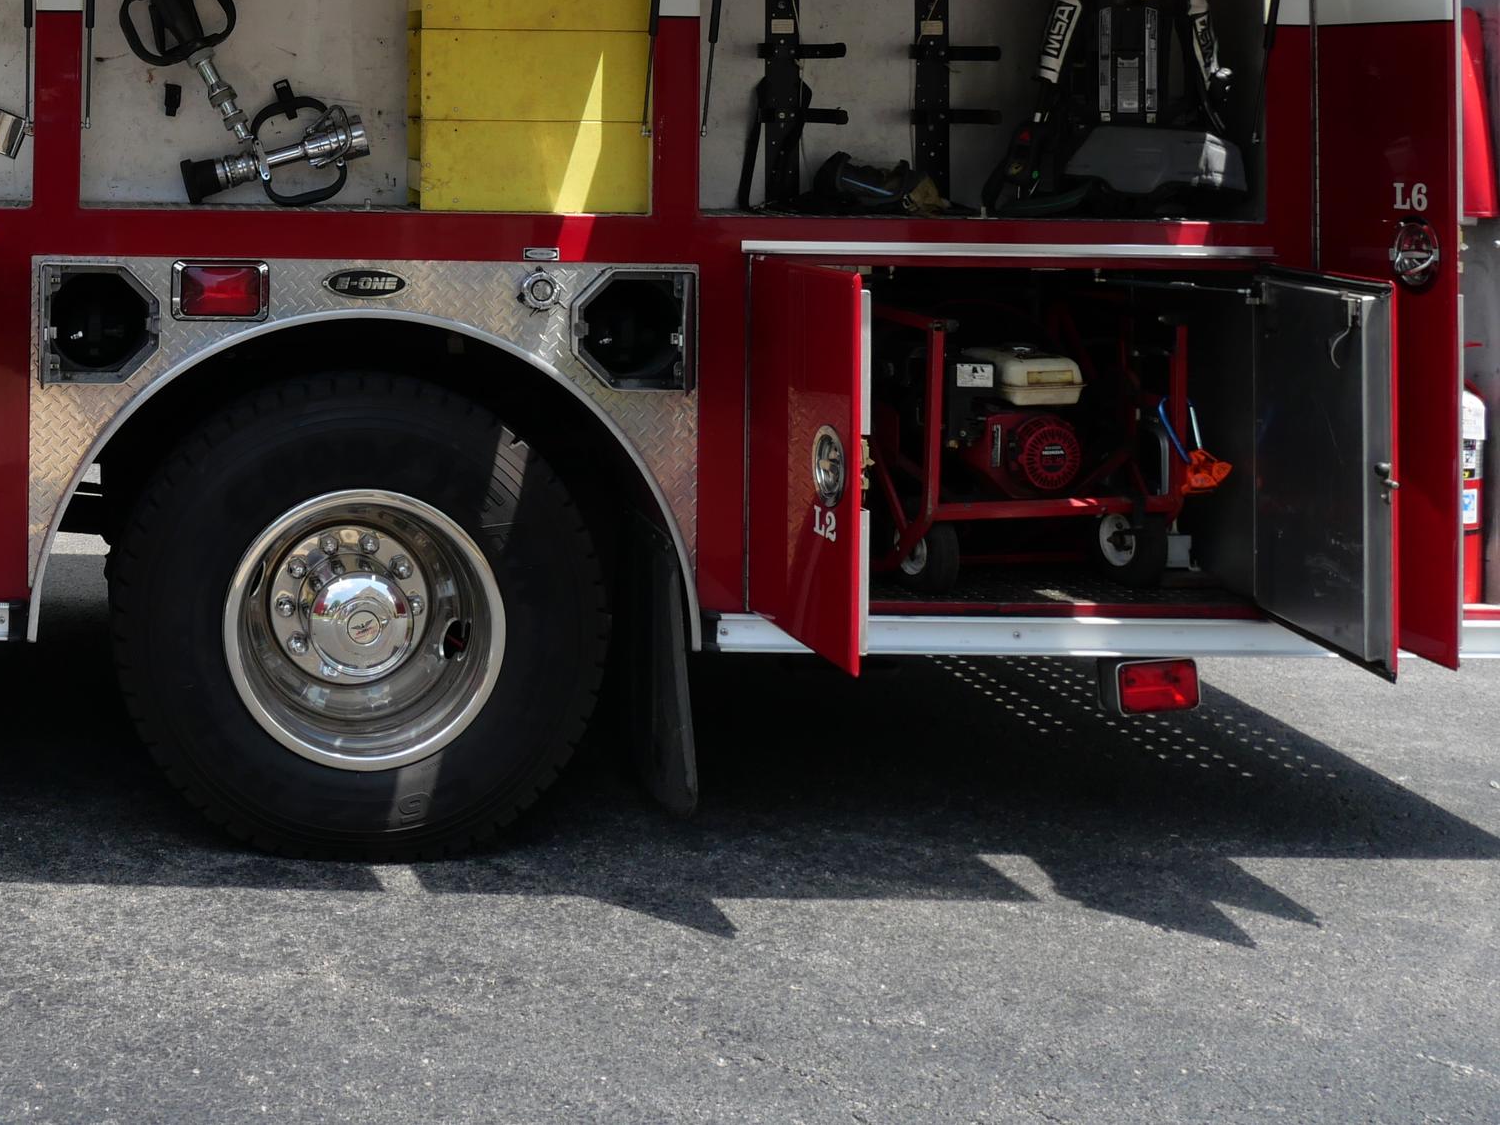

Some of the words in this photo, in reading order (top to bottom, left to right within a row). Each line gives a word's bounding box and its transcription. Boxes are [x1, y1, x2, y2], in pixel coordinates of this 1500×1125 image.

[1047, 6, 1075, 56] MSA
[1393, 182, 1428, 212] L6
[335, 277, 398, 290] E-ONE
[813, 504, 837, 542] L2
